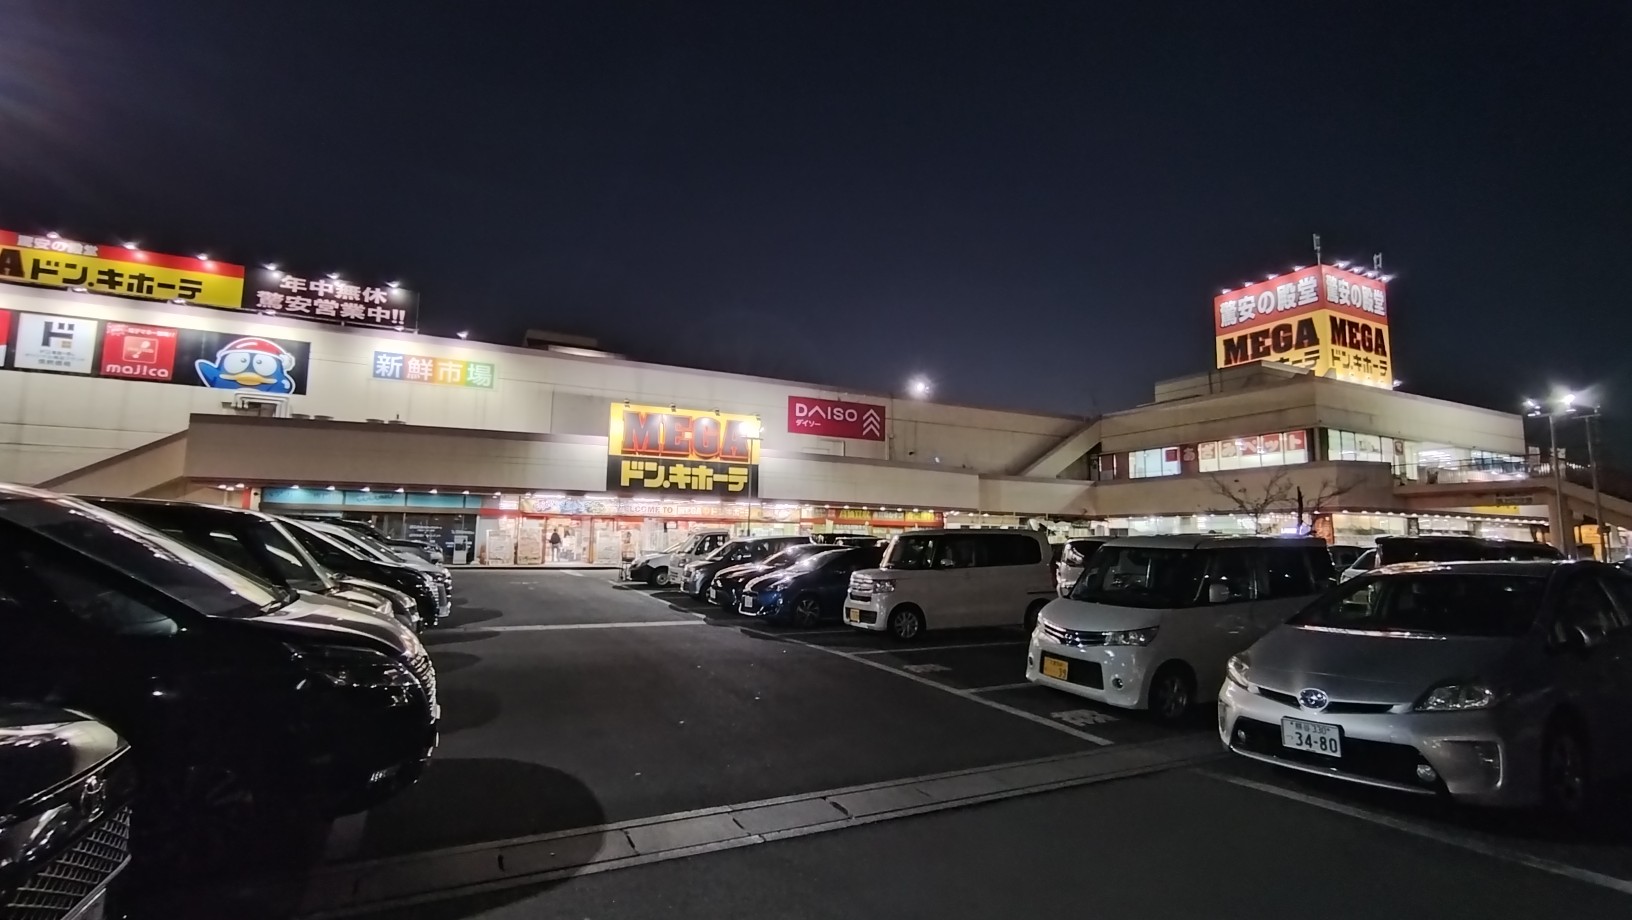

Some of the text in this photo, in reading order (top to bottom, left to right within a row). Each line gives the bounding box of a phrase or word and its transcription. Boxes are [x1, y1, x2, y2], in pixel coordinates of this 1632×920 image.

[279, 275, 388, 304] 年中無休
[1219, 275, 1319, 328] 驚安の殿堂
[1325, 274, 1387, 316] 驚安の殿堂
[41, 321, 75, 347] ド
[1222, 317, 1320, 366] MEGA
[1329, 315, 1387, 357] MEGA
[376, 354, 492, 386] 新鮮市場
[795, 403, 858, 422] DAISO
[795, 419, 822, 428] ダイソー
[621, 411, 749, 462] MEGA
[663, 506, 673, 514] TO
[1295, 731, 1338, 753] 34-80
